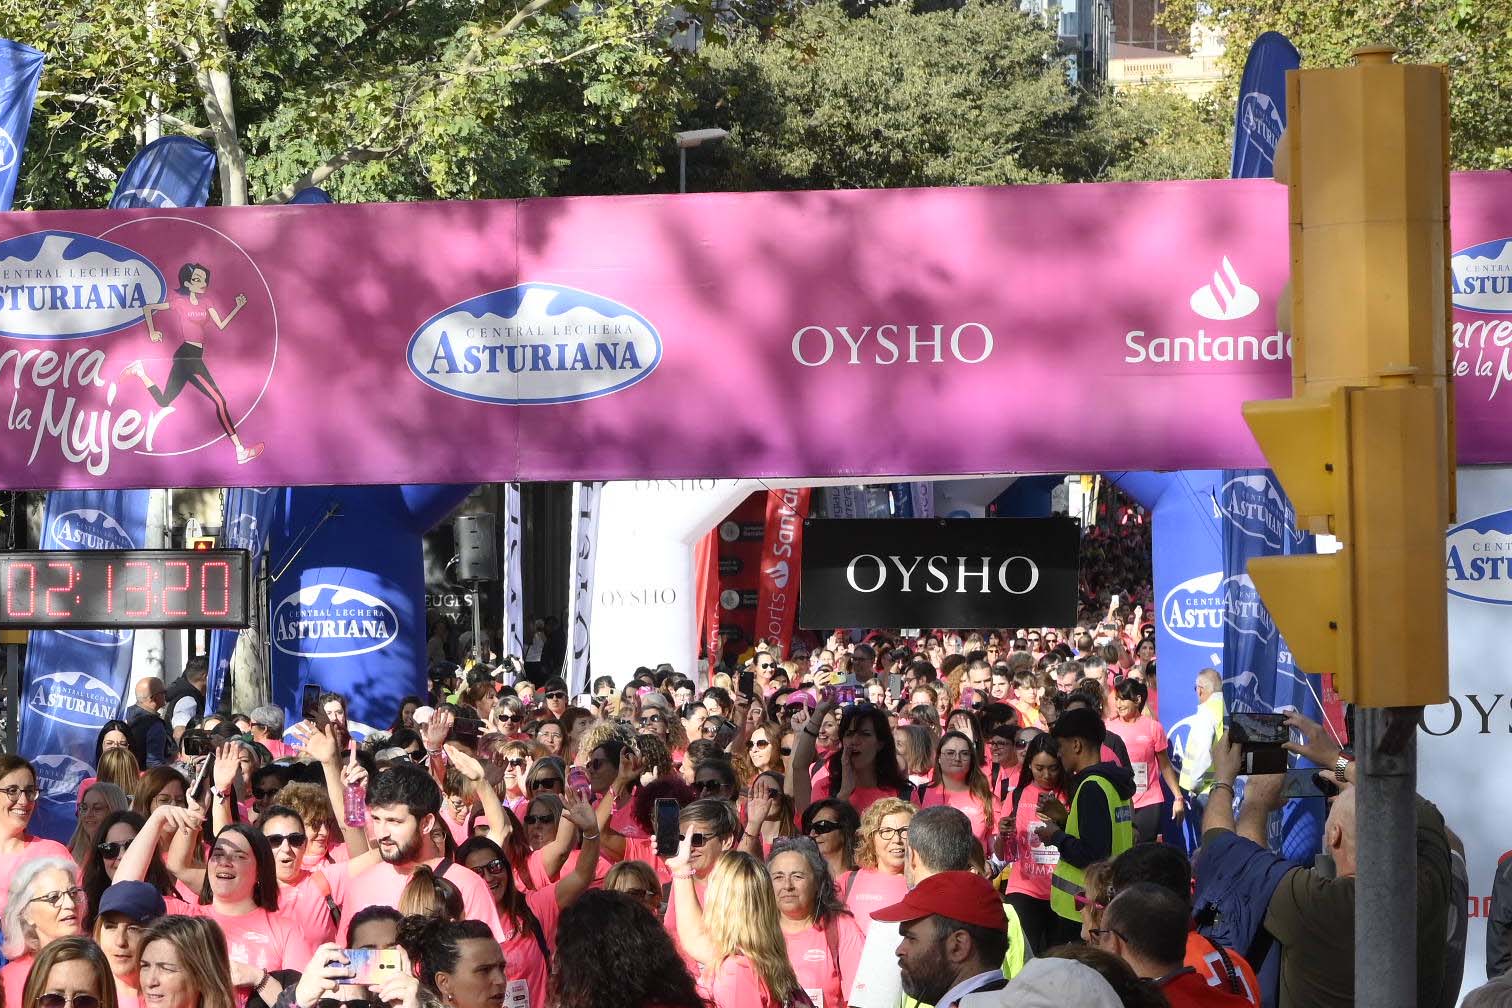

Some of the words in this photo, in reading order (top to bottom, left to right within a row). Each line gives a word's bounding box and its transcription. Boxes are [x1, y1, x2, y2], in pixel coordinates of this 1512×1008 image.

[69, 265, 141, 279] LECHERA
[466, 326, 544, 338] CENTRAL
[553, 323, 633, 336] LECHERA
[791, 322, 994, 367] OYSHO
[427, 331, 642, 375] ASTURIANA
[1125, 330, 1291, 364] Santand
[1475, 350, 1493, 376] la
[7, 391, 32, 431] la
[27, 384, 176, 476] Mujer
[1472, 543, 1512, 552] CENT
[7, 562, 229, 616] 02:13:20
[846, 554, 1040, 595] OYSHO
[601, 587, 677, 608] OYSHO
[277, 614, 390, 642] ASTURIANA
[336, 609, 385, 618] LECHERA
[31, 684, 118, 721] ASTURIANA
